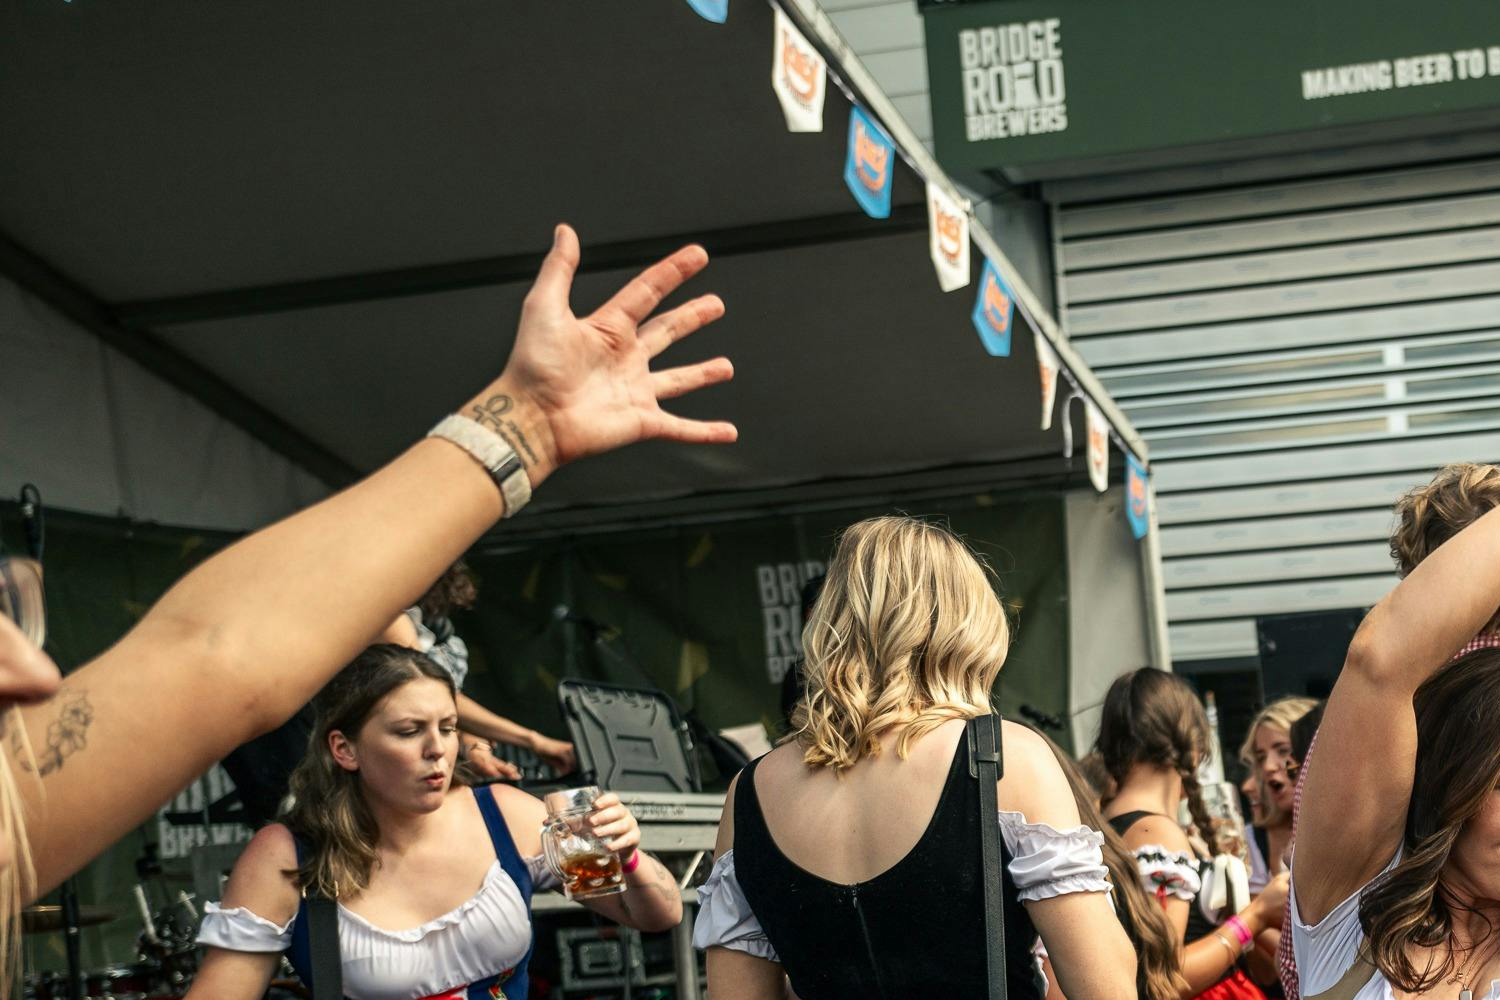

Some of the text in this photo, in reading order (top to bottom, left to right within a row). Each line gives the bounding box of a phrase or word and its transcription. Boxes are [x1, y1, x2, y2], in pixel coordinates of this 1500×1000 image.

[959, 18, 1062, 69] BRIDGE
[1302, 62, 1393, 100] MAKING
[1394, 54, 1453, 88] BEER
[1454, 49, 1486, 80] TO
[967, 104, 1067, 142] BREWERS
